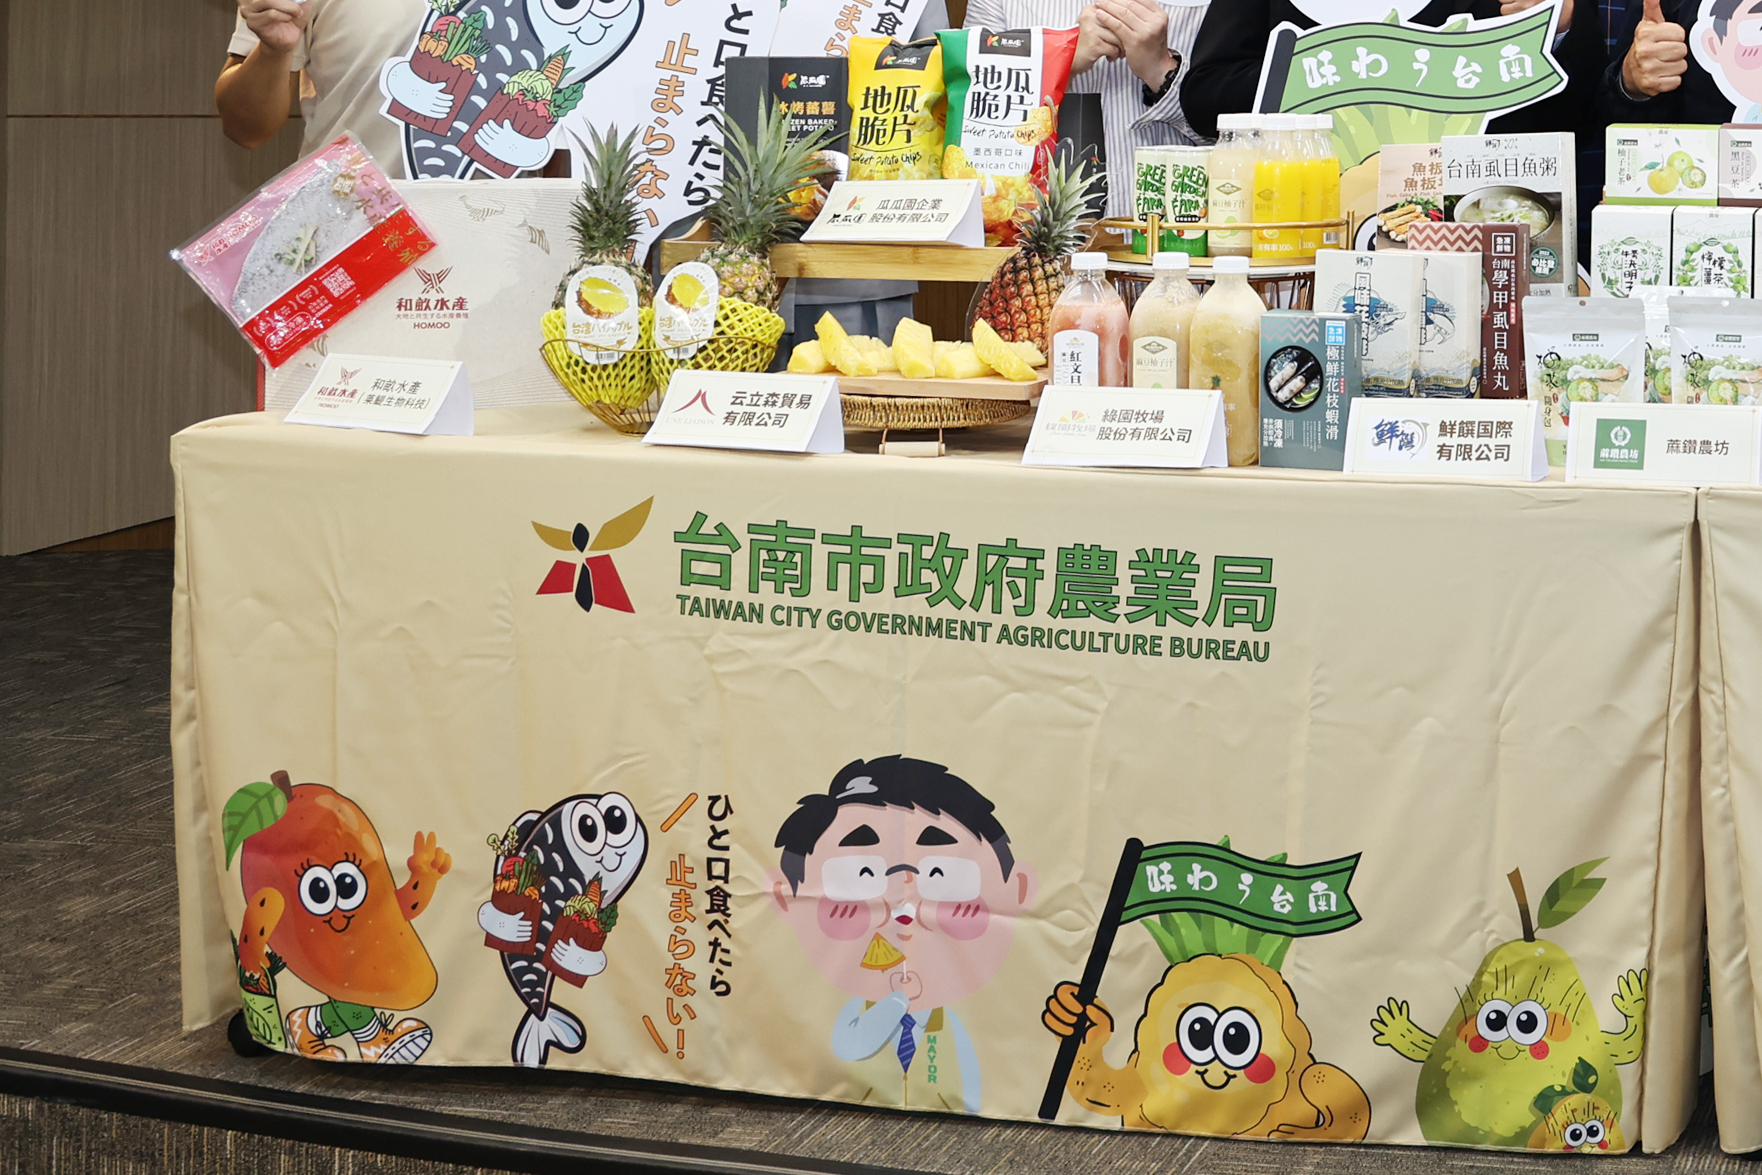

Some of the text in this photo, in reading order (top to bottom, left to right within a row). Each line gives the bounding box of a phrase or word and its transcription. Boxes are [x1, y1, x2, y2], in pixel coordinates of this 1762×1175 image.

[972, 65, 1034, 95] 地瓜
[859, 85, 921, 115] 地瓜
[968, 91, 1034, 123] 脆片
[856, 114, 917, 147] 脆片
[965, 160, 1005, 170] Mexican
[876, 198, 944, 211] 瓜瓜園企業
[868, 212, 950, 224] 股份有限公司
[413, 321, 451, 329] HOMOO
[730, 390, 813, 410] 云立森貿易
[1325, 345, 1340, 441] 極鮮花枝蝦滑
[722, 411, 790, 428] 有限公司
[1101, 409, 1165, 425] 綠園牧場
[1096, 426, 1193, 444] 股份有限公司
[1436, 443, 1511, 462] 有限公司
[673, 511, 1278, 633] 台南市政府農業局
[676, 594, 1271, 663] TAIWAN CITY GOVERNMENT AGRICULTURE BUREAU
[704, 793, 735, 999] ひと口食べたら
[1145, 861, 1339, 916] 味わう台南
